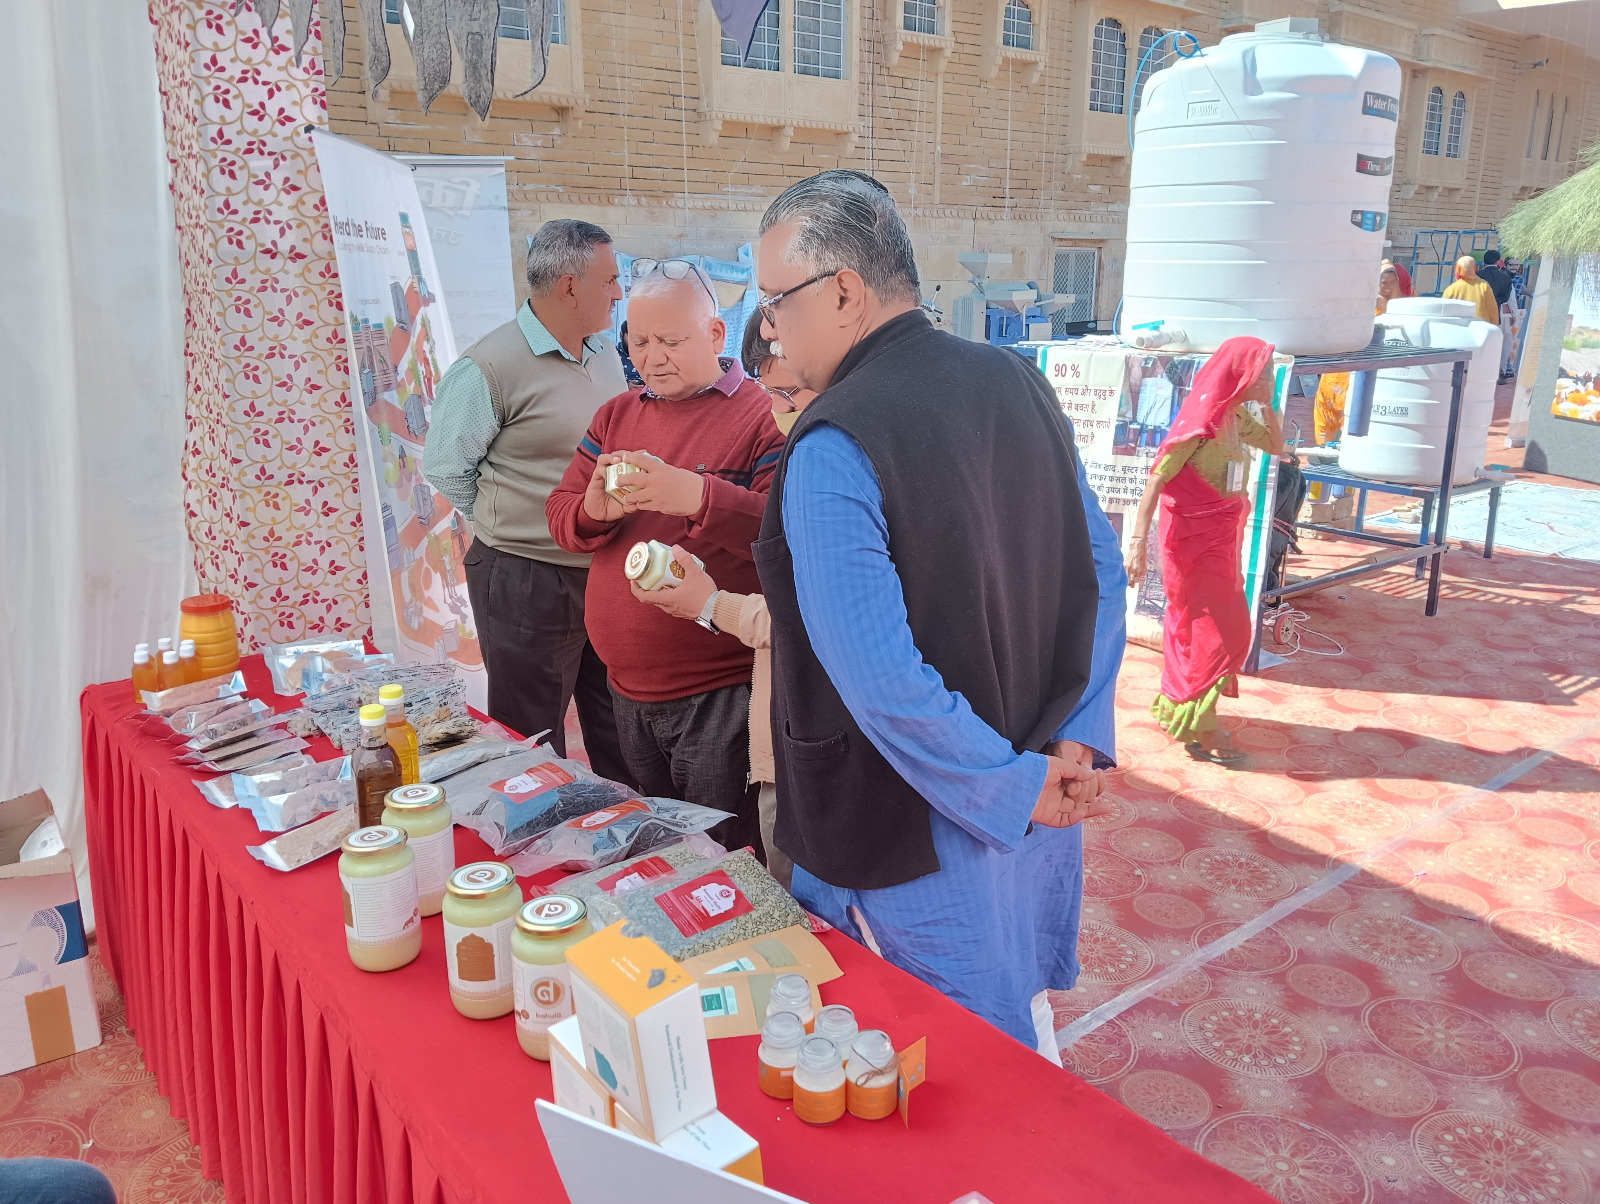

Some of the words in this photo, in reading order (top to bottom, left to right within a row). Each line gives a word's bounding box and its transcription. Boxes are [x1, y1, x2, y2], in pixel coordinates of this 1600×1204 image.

[1366, 94, 1388, 110] Water
[333, 214, 351, 237] Herd
[350, 218, 364, 239] the
[364, 220, 387, 241] Future
[1054, 363, 1067, 378] 90
[1070, 363, 1081, 378] %
[1064, 387, 1080, 396] समय
[1080, 385, 1092, 397] और
[1108, 386, 1116, 398] के
[1066, 399, 1073, 411] से
[1380, 405, 1387, 417] 3
[1387, 405, 1409, 416] LAYER
[1108, 475, 1127, 484] फसल
[1128, 474, 1138, 485] को
[1105, 486, 1121, 494] उपज
[1107, 497, 1120, 506] कम
